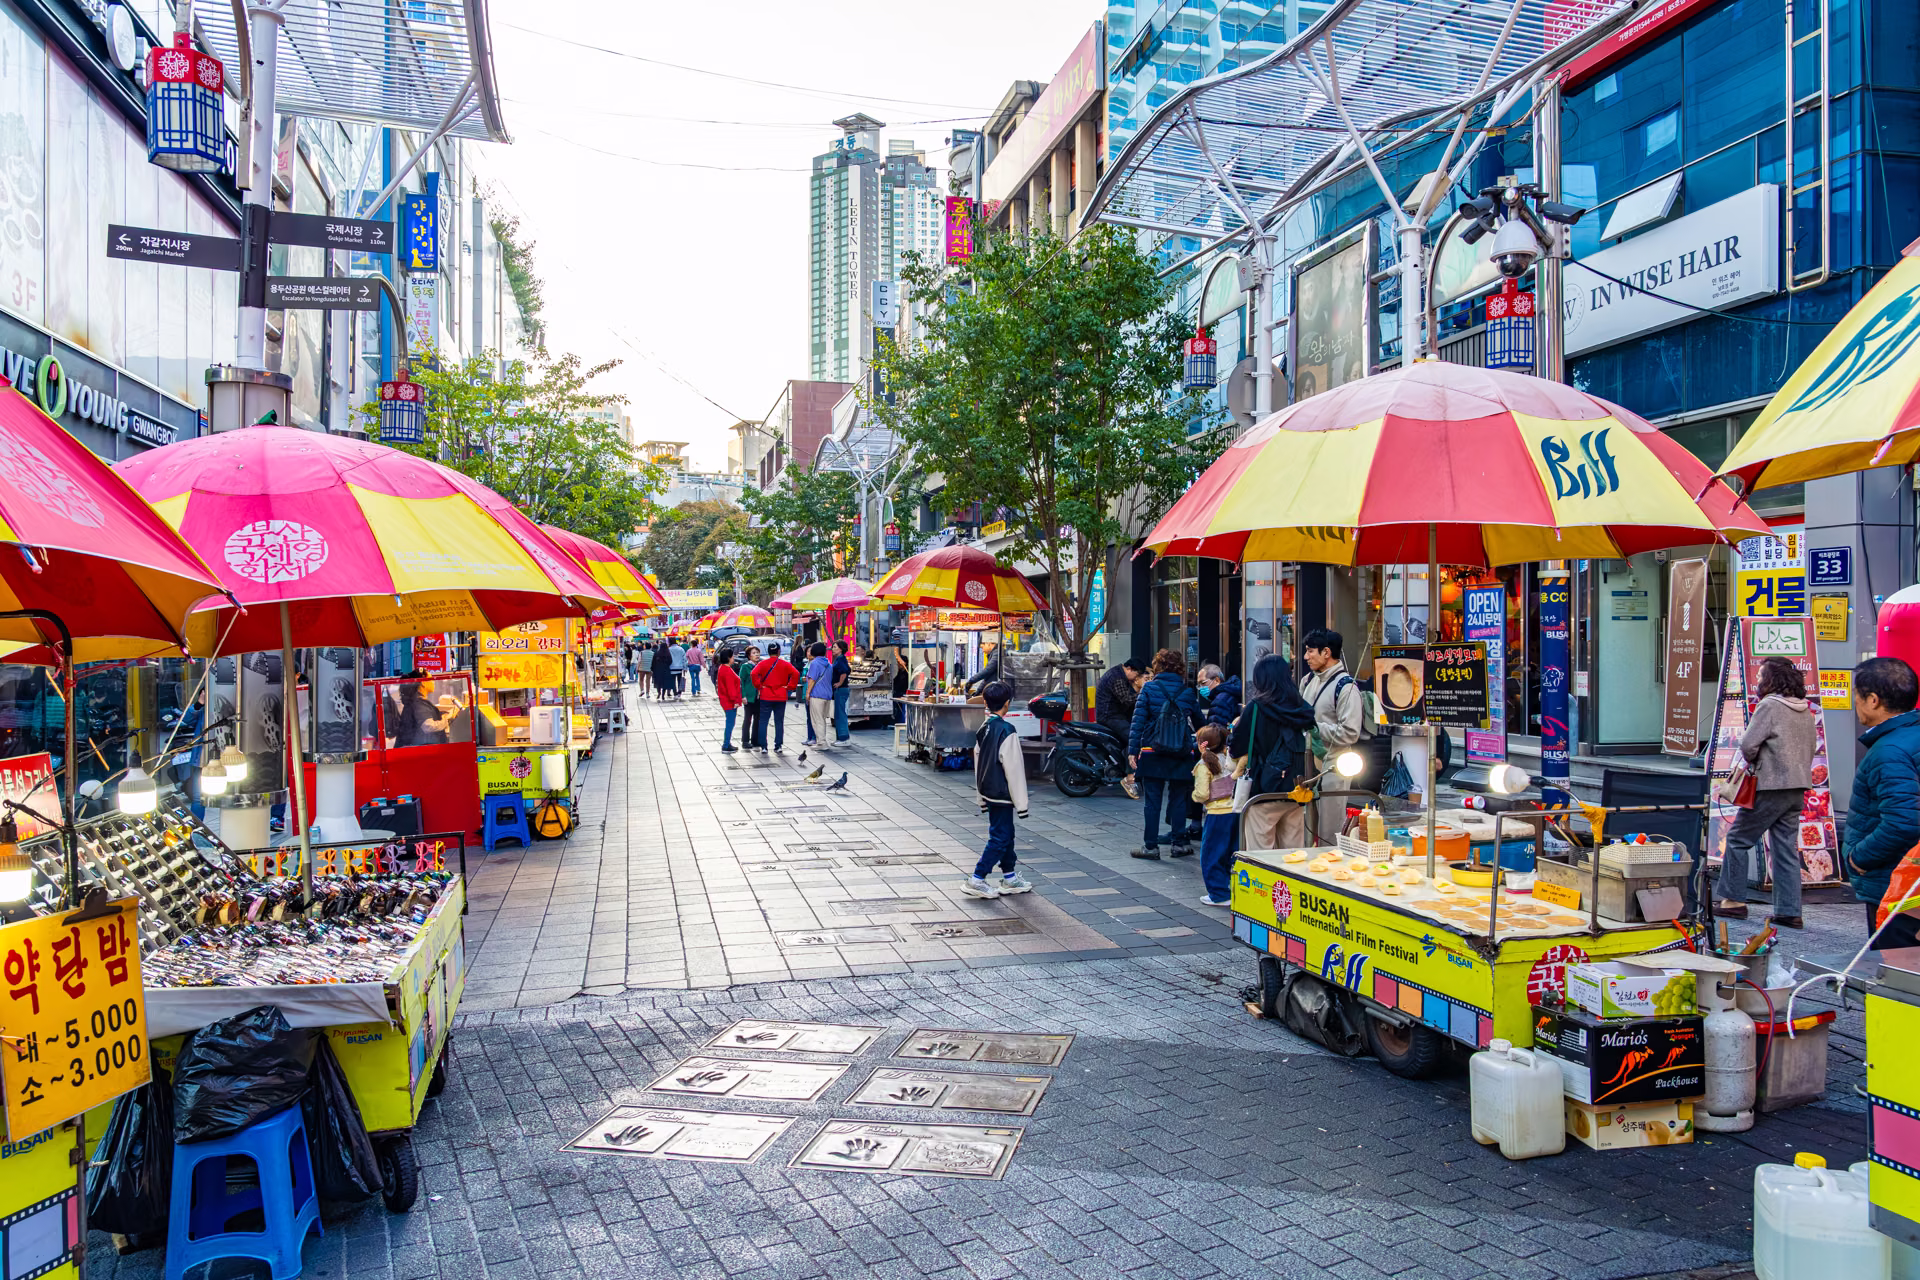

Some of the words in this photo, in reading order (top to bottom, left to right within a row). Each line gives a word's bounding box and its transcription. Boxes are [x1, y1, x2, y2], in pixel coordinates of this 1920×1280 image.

[325, 223, 363, 236] 국제시장
[115, 244, 133, 252] 290m
[140, 235, 191, 251] 자갈치시장
[327, 235, 344, 243] Gukje
[140, 247, 164, 256] Jagalchi
[164, 250, 185, 258] Market
[848, 250, 859, 300] TOWER
[1590, 282, 1613, 311] IN
[1617, 259, 1673, 301] WISE
[1678, 235, 1742, 280] HAIR
[270, 284, 306, 295] 용두산공원
[307, 285, 351, 296] 에스컬레이터
[66, 377, 129, 433] YOUNG
[132, 415, 178, 446] GWANGBOK
[1817, 559, 1842, 575] 33
[1468, 591, 1500, 613] OPEN
[1745, 576, 1805, 617] 건물
[1758, 626, 1799, 644] حلال
[485, 638, 528, 651] 회오리
[537, 638, 563, 650] 감자
[1758, 643, 1799, 651] HALAL
[523, 659, 559, 684] 치즈
[1675, 661, 1693, 679] 4F
[1791, 658, 1812, 671] ndia
[1299, 890, 1350, 925] BUSAN
[1299, 911, 1354, 942] Internatioal
[1355, 931, 1377, 950] Film
[1378, 939, 1419, 966] Festival
[4, 914, 131, 1015] 약단밤
[1447, 953, 1473, 969] BUSAN
[346, 1033, 383, 1045] BUSAN
[1535, 1026, 1558, 1044] Mario's
[1601, 1029, 1649, 1048] Mario's
[1655, 1075, 1699, 1089] Packhouse
[1621, 1120, 1647, 1133] 상주배
[1, 1127, 55, 1159] BUSAN
